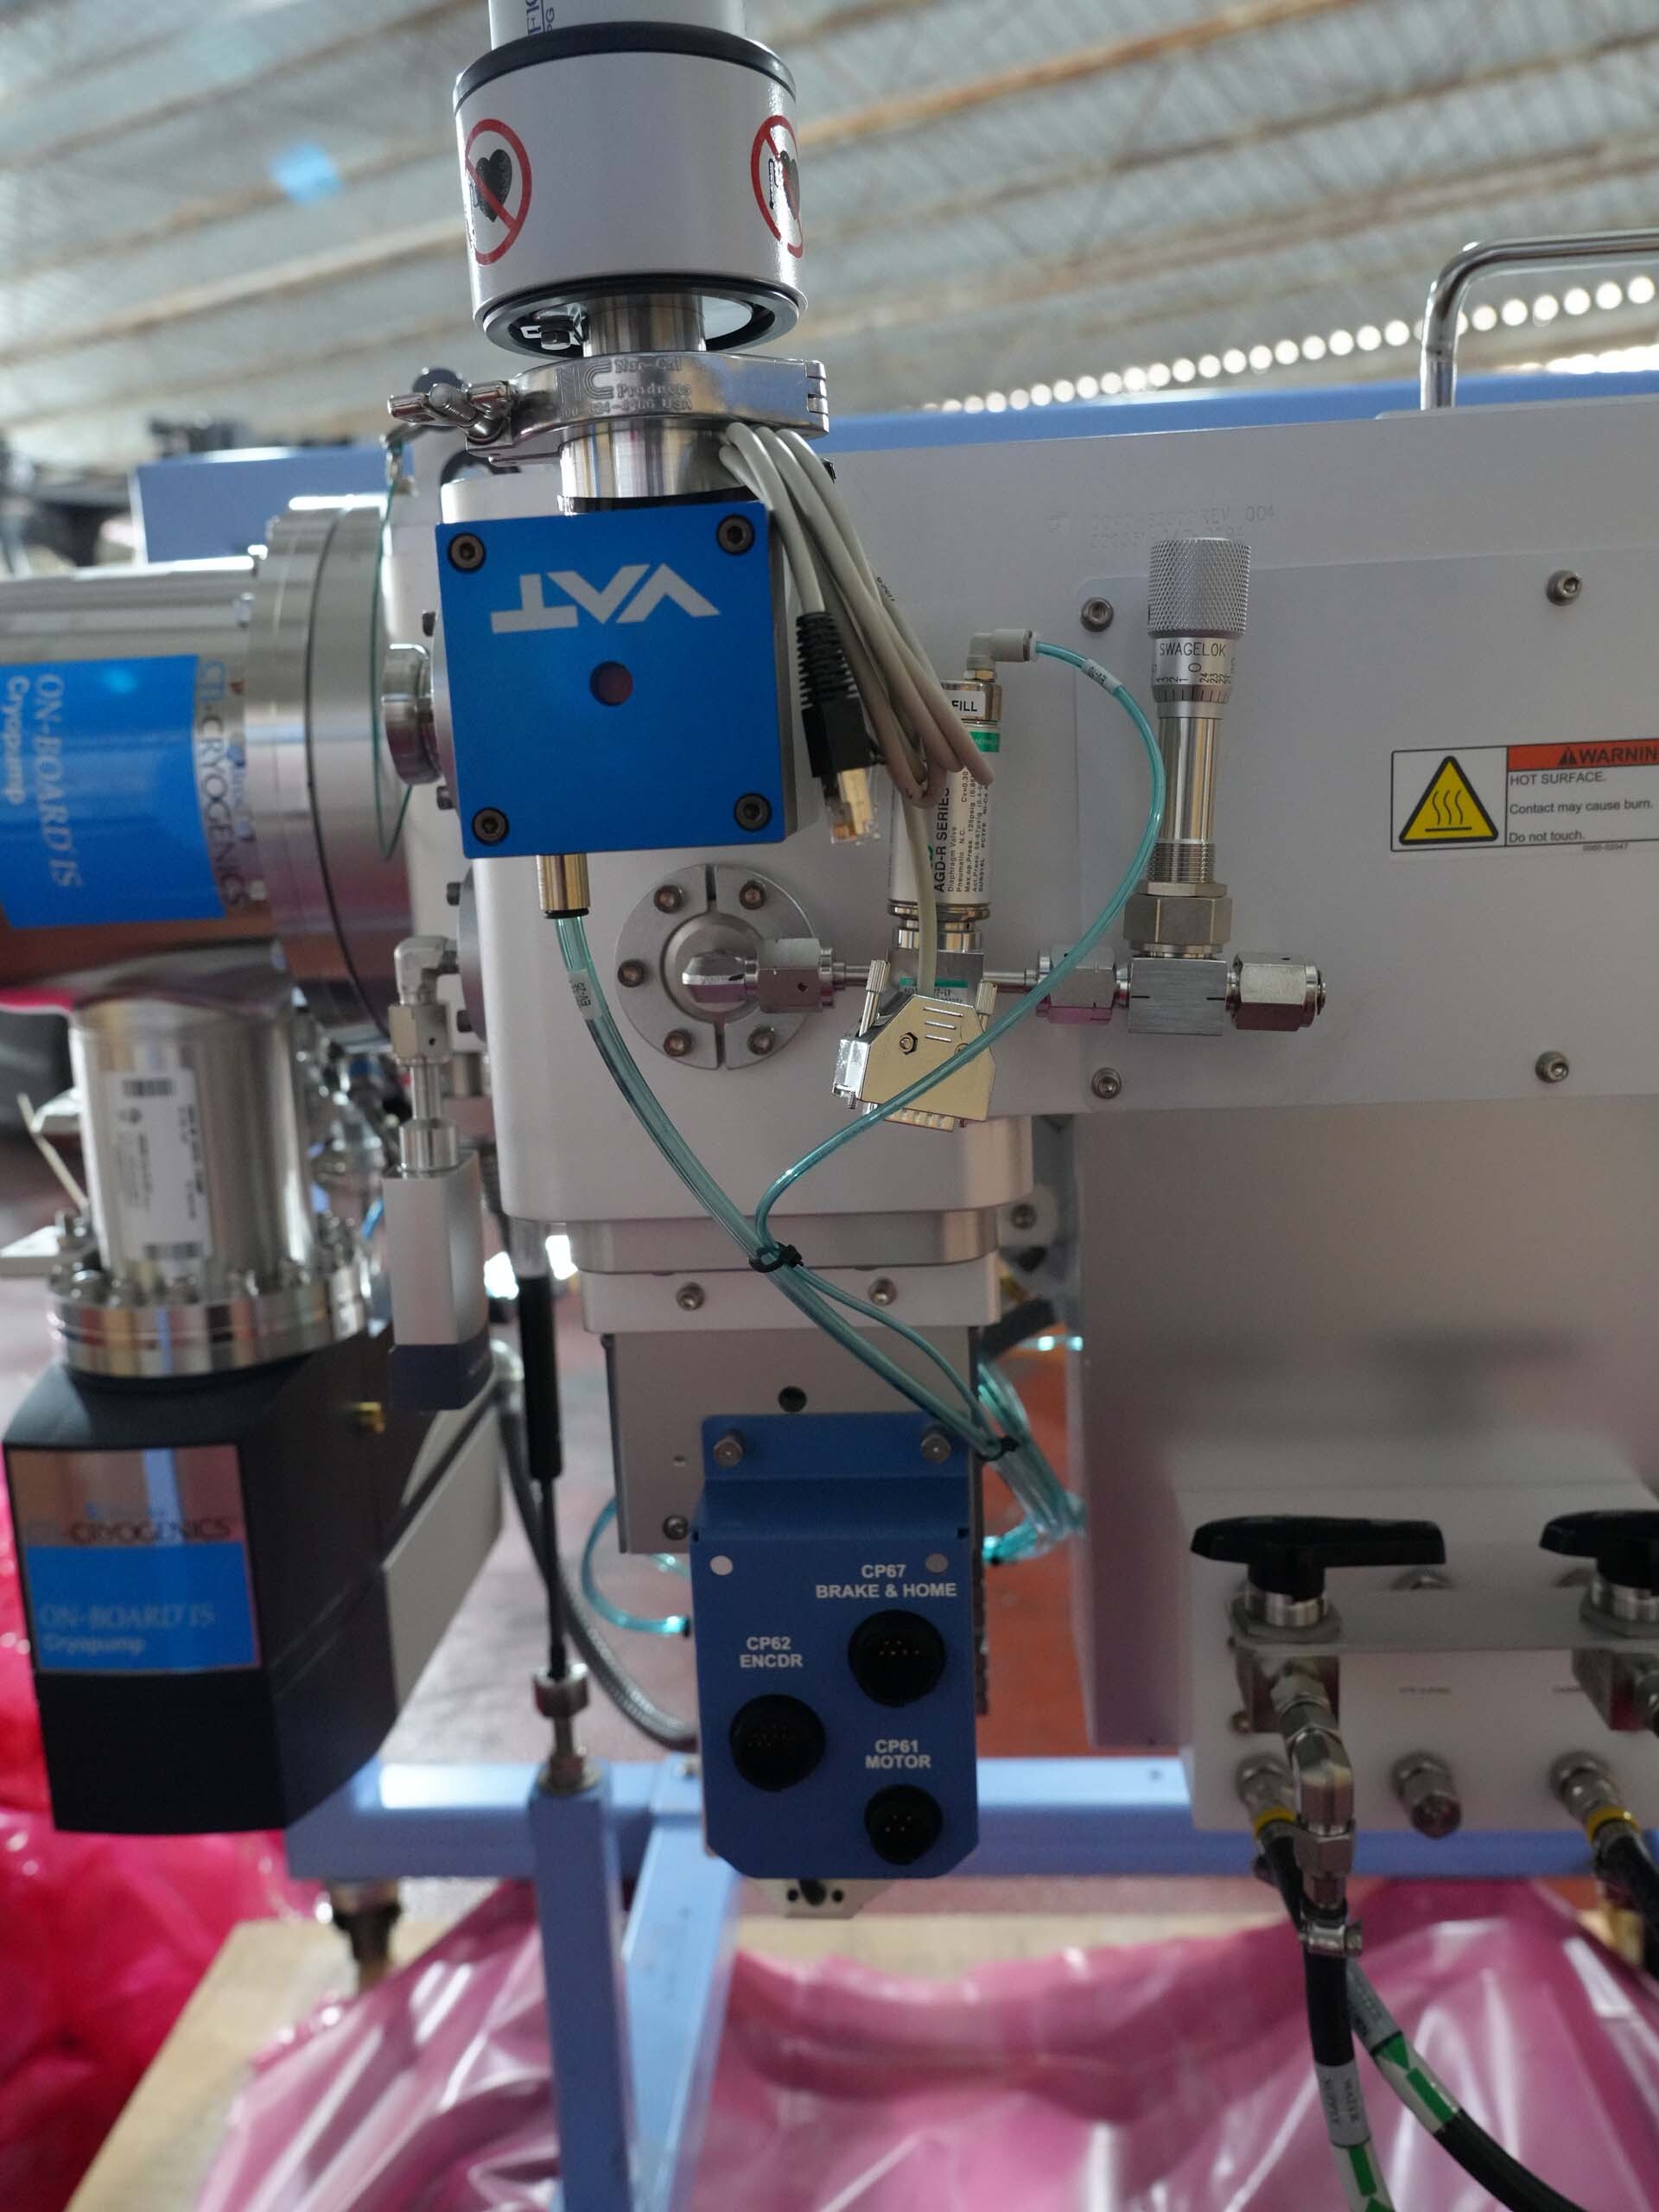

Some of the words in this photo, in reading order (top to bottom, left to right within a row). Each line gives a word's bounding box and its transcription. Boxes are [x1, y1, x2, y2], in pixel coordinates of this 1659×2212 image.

[490, 562, 721, 634] VAT
[1159, 642, 1227, 657] SWAGELOK
[32, 671, 74, 849] ON-BOARD
[1578, 746, 1659, 764] WARNIN
[1510, 774, 1537, 787] HOT
[1541, 771, 1606, 785] SURFACE.
[1509, 804, 1554, 817] Contact
[1558, 804, 1583, 815] may
[1586, 800, 1621, 812] cause
[1624, 797, 1654, 810] burn.
[950, 825, 958, 848] Valve
[1510, 833, 1526, 843] Do
[1529, 830, 1546, 843] not
[1549, 829, 1586, 842] touch.
[934, 844, 947, 893] AGD-R
[947, 849, 957, 893] Diaphragm
[957, 851, 966, 893] Pneumatic
[861, 1564, 906, 1580] CP67
[816, 1584, 880, 1599] BRAKE
[884, 1583, 899, 1599] &
[902, 1582, 957, 1598] HOME
[746, 1636, 791, 1651] CP62
[740, 1654, 804, 1669] ENCDR
[874, 1738, 918, 1754] CP61
[865, 1755, 931, 1770] MOTOR
